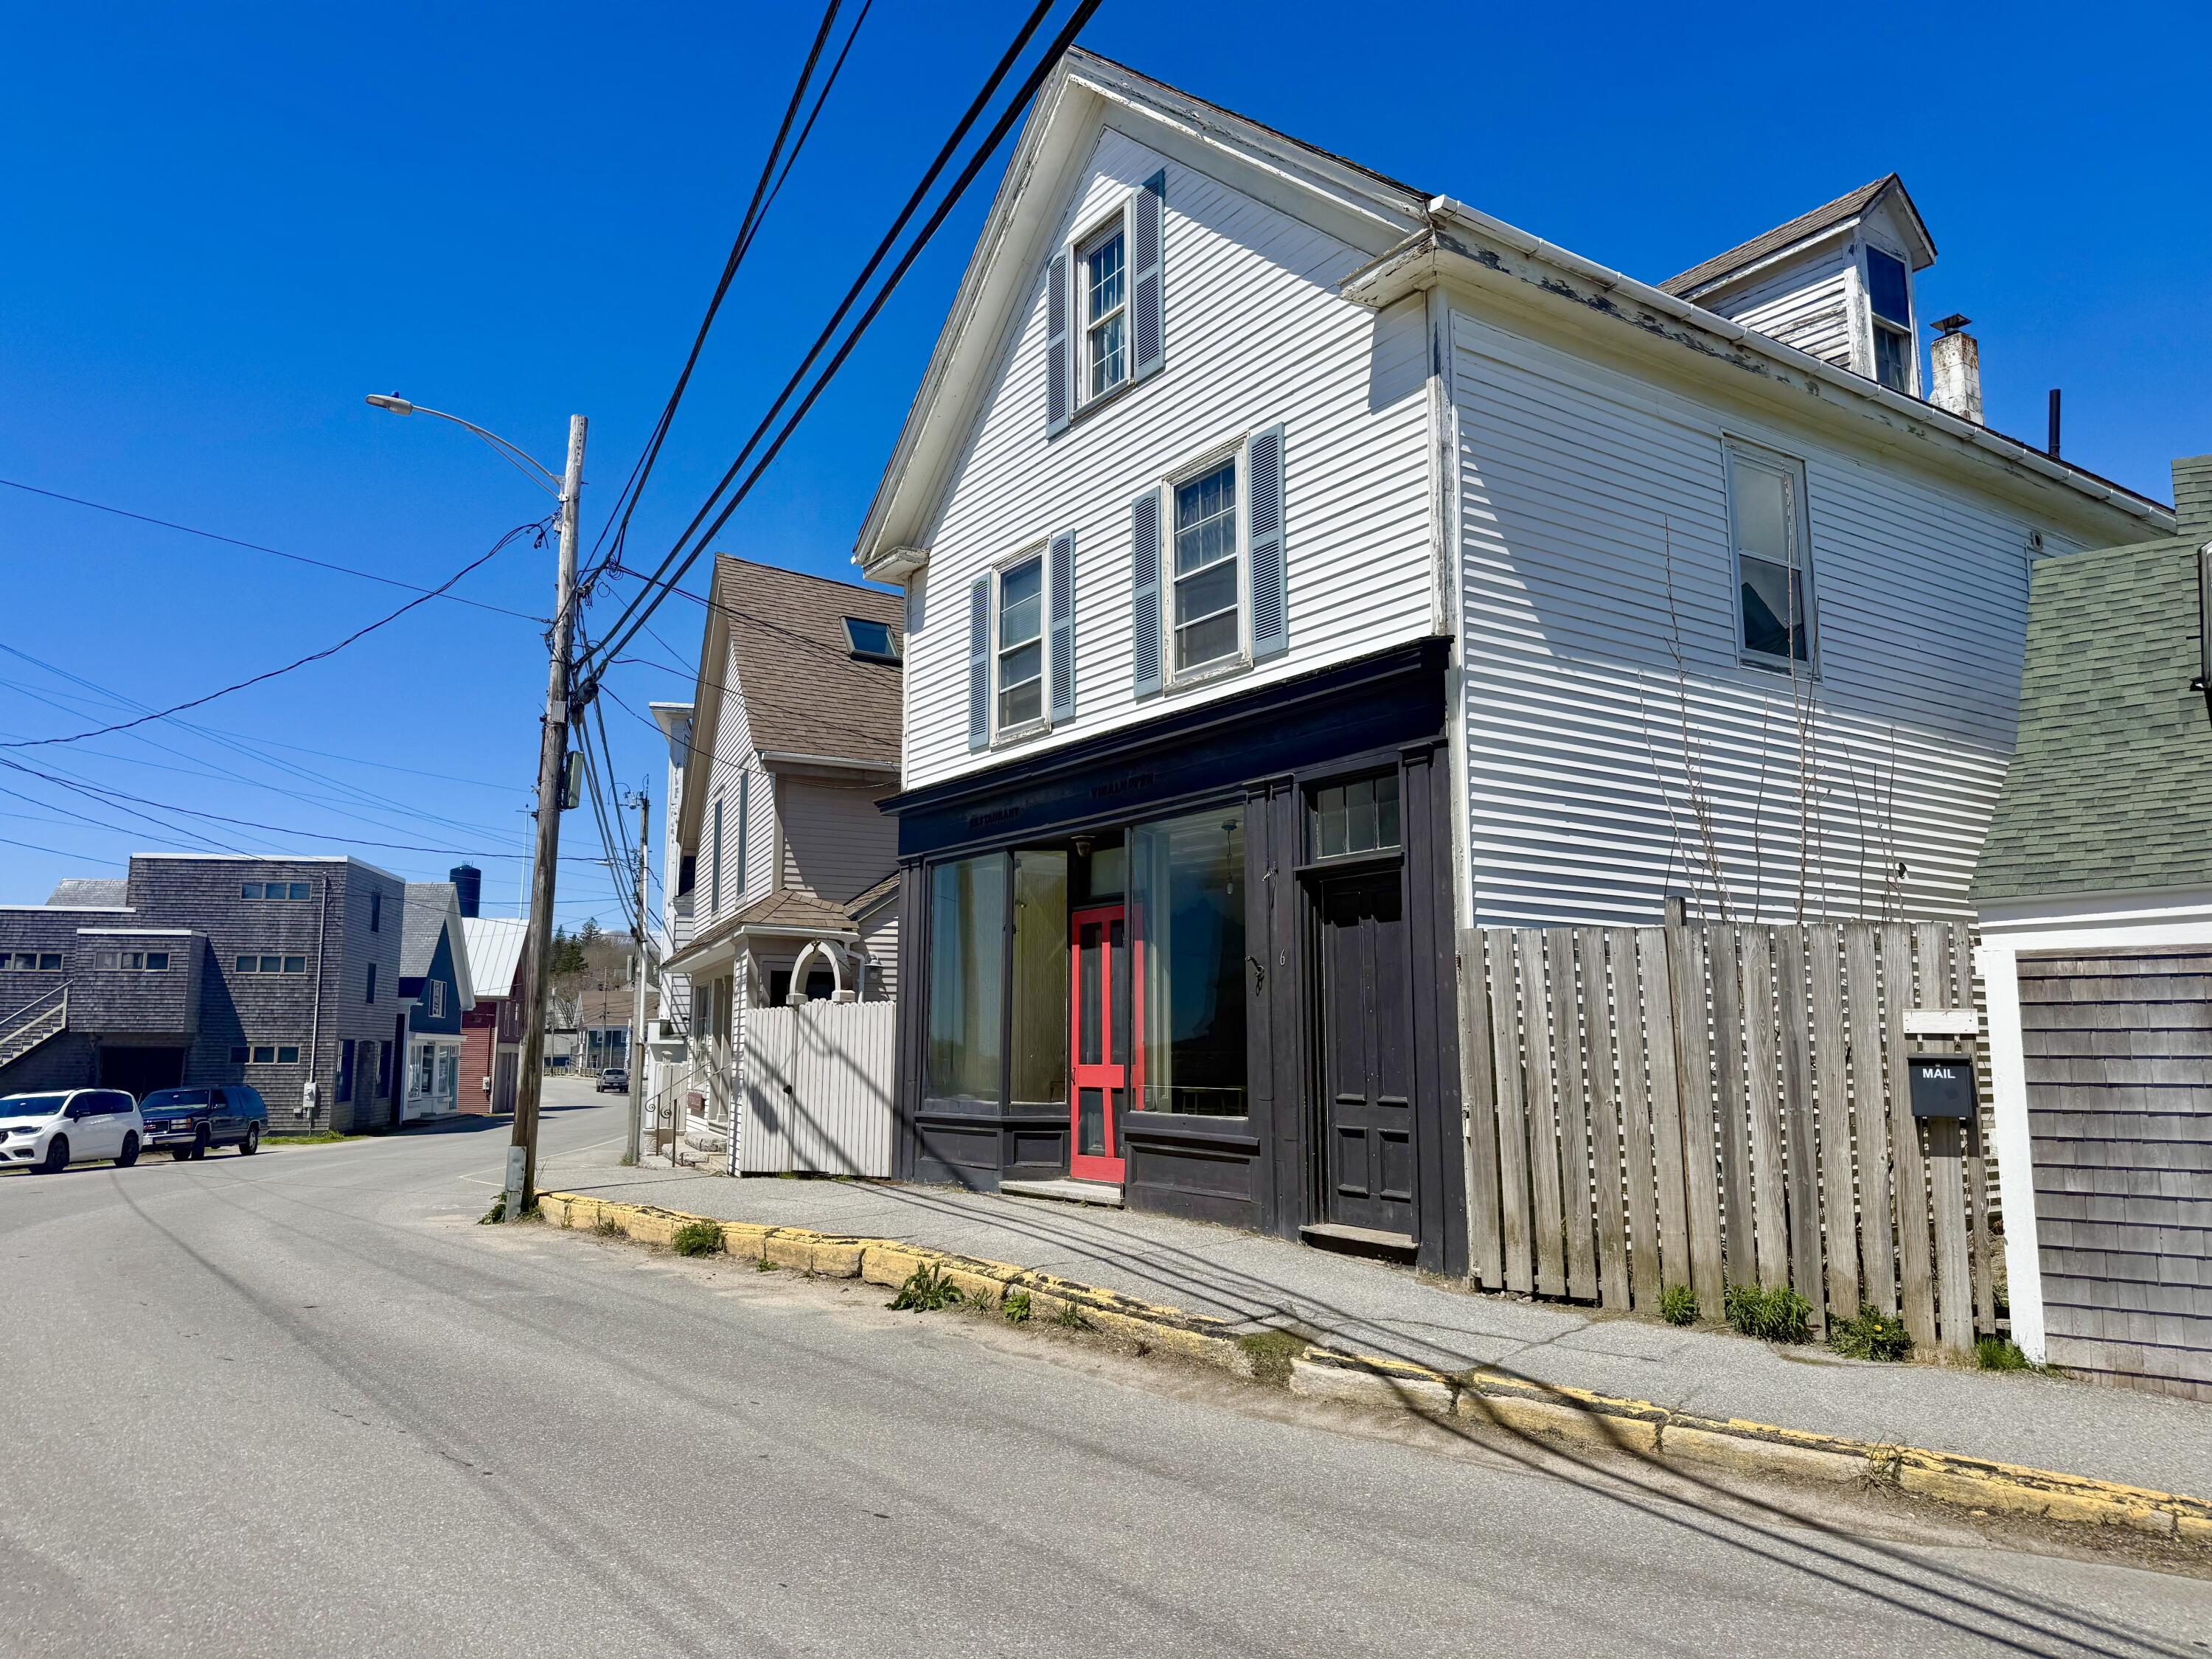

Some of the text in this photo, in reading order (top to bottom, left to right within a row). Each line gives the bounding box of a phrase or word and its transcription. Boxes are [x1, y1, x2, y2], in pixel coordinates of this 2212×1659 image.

[970, 807, 1020, 827] RESTAURANT
[1280, 949, 1285, 966] 6
[1922, 1068, 1956, 1079] MAIL
